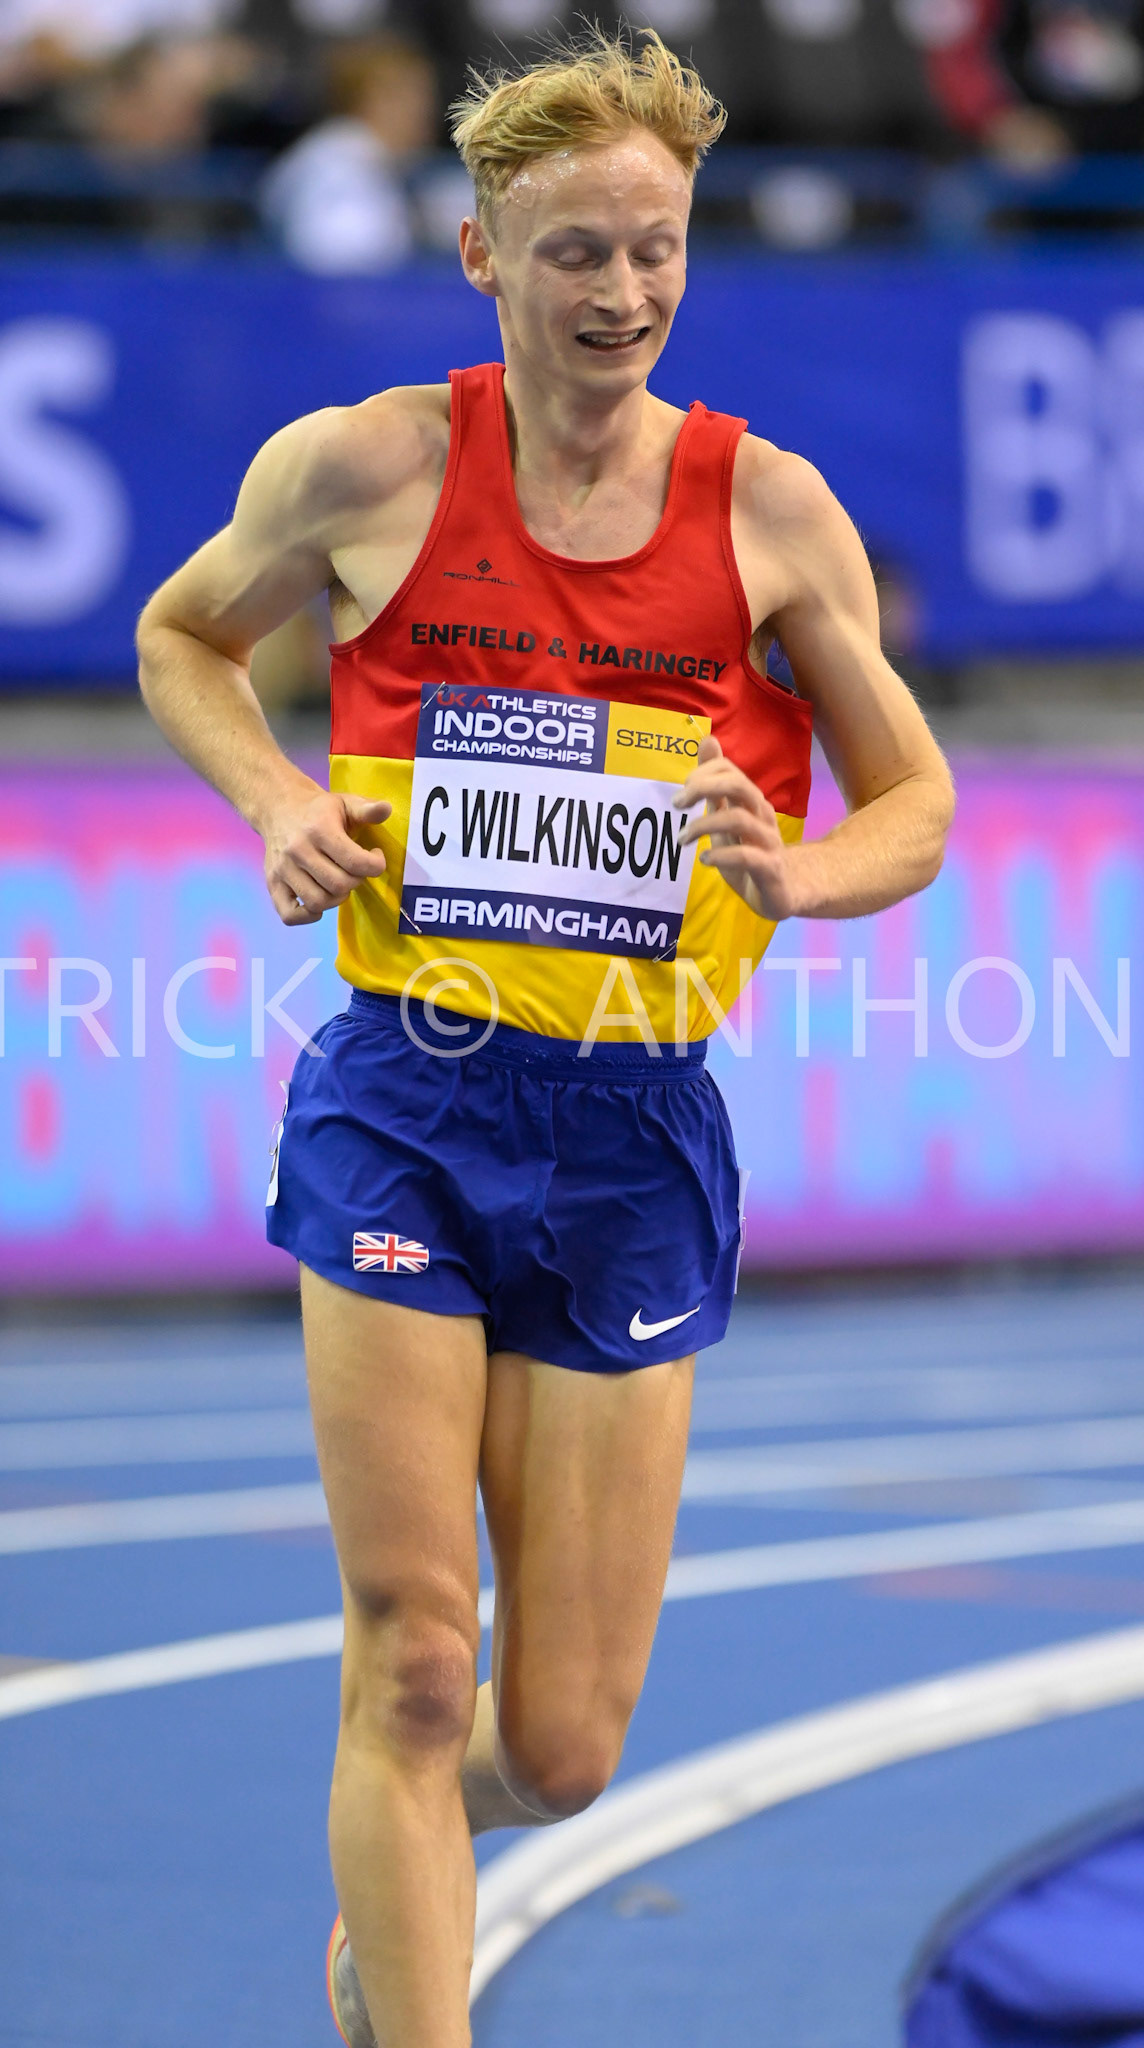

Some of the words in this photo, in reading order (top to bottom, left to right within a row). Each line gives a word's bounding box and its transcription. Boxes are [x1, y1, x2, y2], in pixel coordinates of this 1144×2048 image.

[443, 572, 520, 587] RONHILL
[411, 623, 536, 653] ENFIELD
[547, 637, 567, 659] &
[578, 642, 727, 683] HARINGEY
[436, 690, 467, 707] UK
[471, 692, 597, 721] ATHLETICS
[434, 709, 595, 749] INDOOR
[616, 728, 699, 757] SEIKO
[432, 739, 593, 765] CHAMPIONSHIPS
[422, 786, 449, 857] C
[461, 788, 688, 882] WILKINSON
[413, 896, 669, 948] BIRMINGHAM
